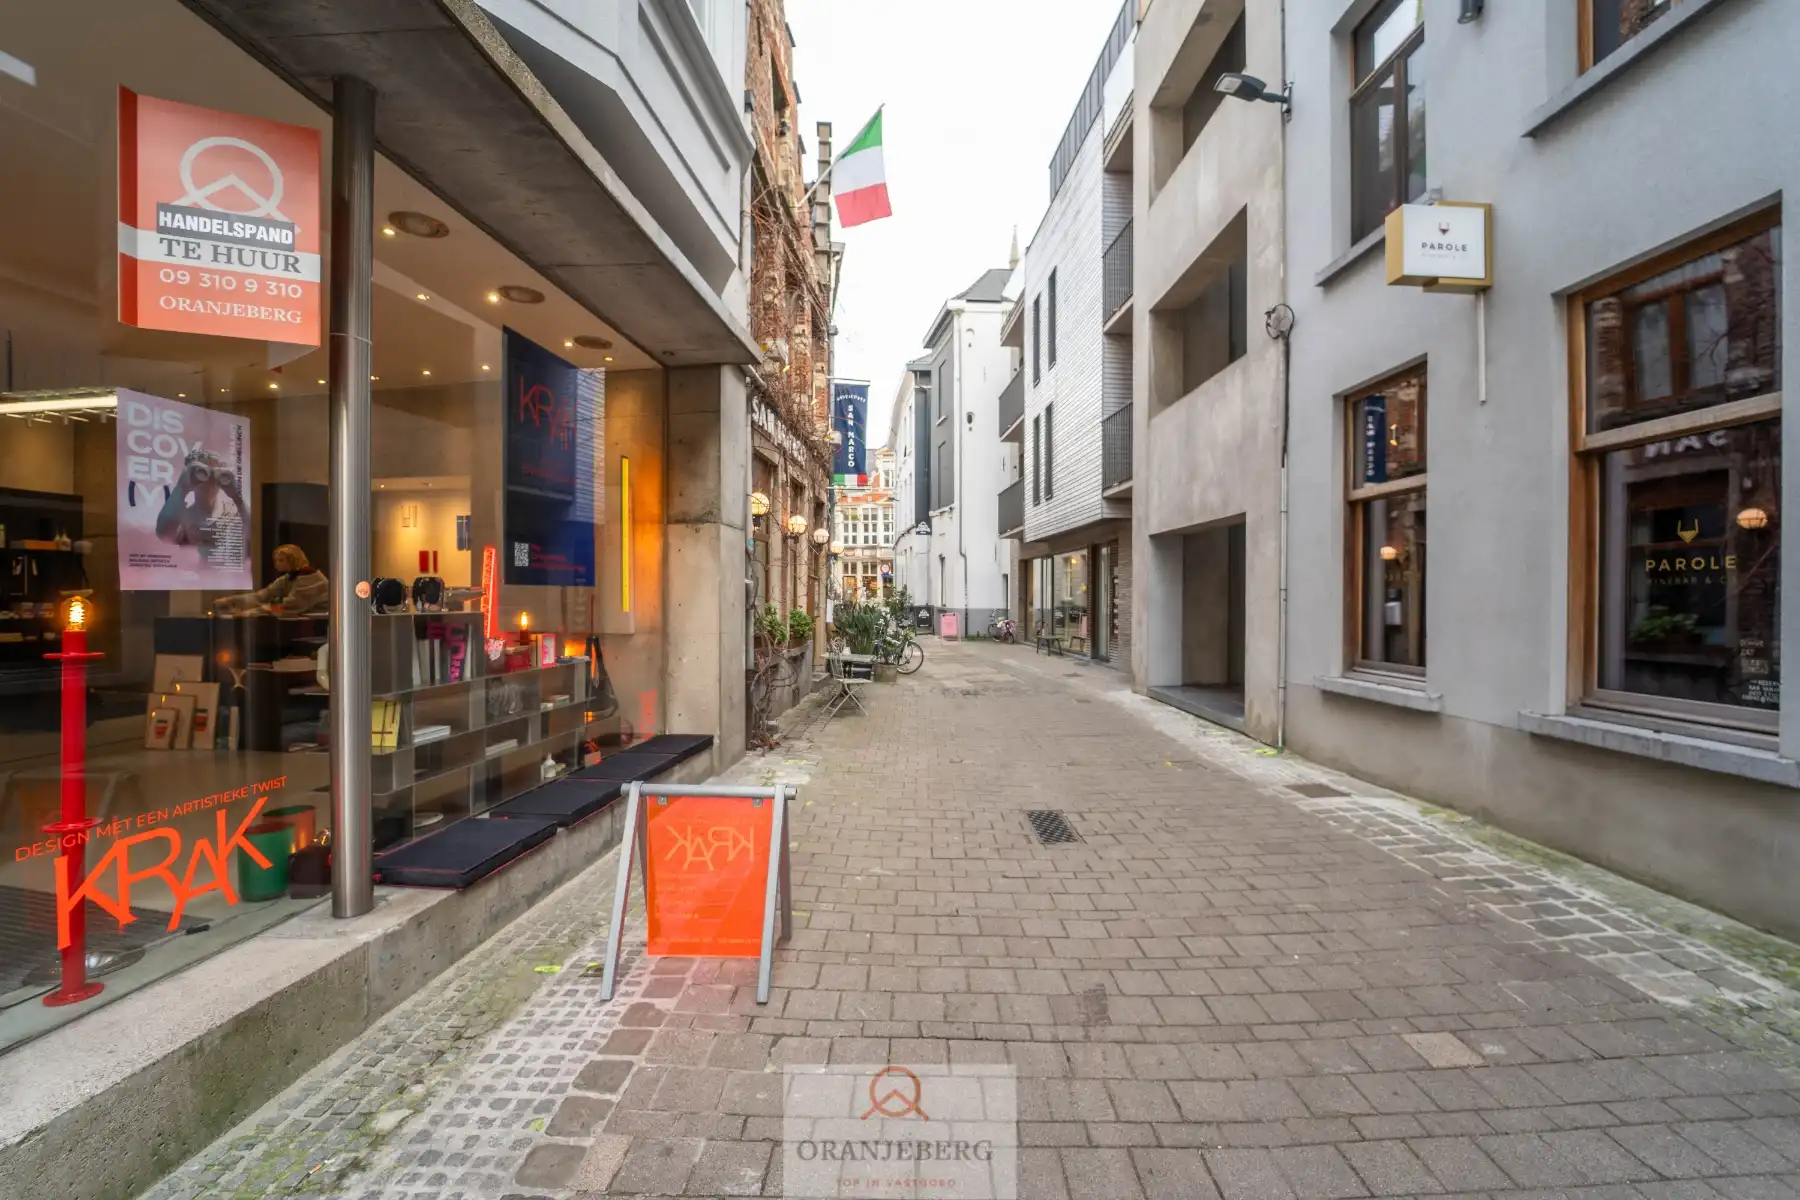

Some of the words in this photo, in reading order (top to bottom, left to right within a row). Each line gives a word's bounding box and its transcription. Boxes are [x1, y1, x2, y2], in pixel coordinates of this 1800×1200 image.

[159, 211, 293, 245] HANDELSPAND
[159, 237, 201, 261] TE
[210, 244, 302, 273] HUUR
[1421, 242, 1467, 252] PAROLE
[159, 268, 190, 284] 09
[199, 272, 237, 291] 310
[244, 278, 258, 293] 9
[265, 281, 302, 298] 310
[159, 295, 302, 324] ORANJEBERG
[127, 401, 184, 434] DIS
[127, 430, 203, 459] COV
[847, 431, 856, 468] MARCO
[127, 455, 173, 485] ER
[1645, 555, 1737, 573] PAROLE
[15, 831, 90, 862] DESIGN
[96, 818, 132, 838] MET
[136, 808, 170, 828] EEN
[172, 786, 249, 817] ARTISTIEKE
[251, 775, 287, 795] TWIST
[54, 796, 273, 950] KRAK
